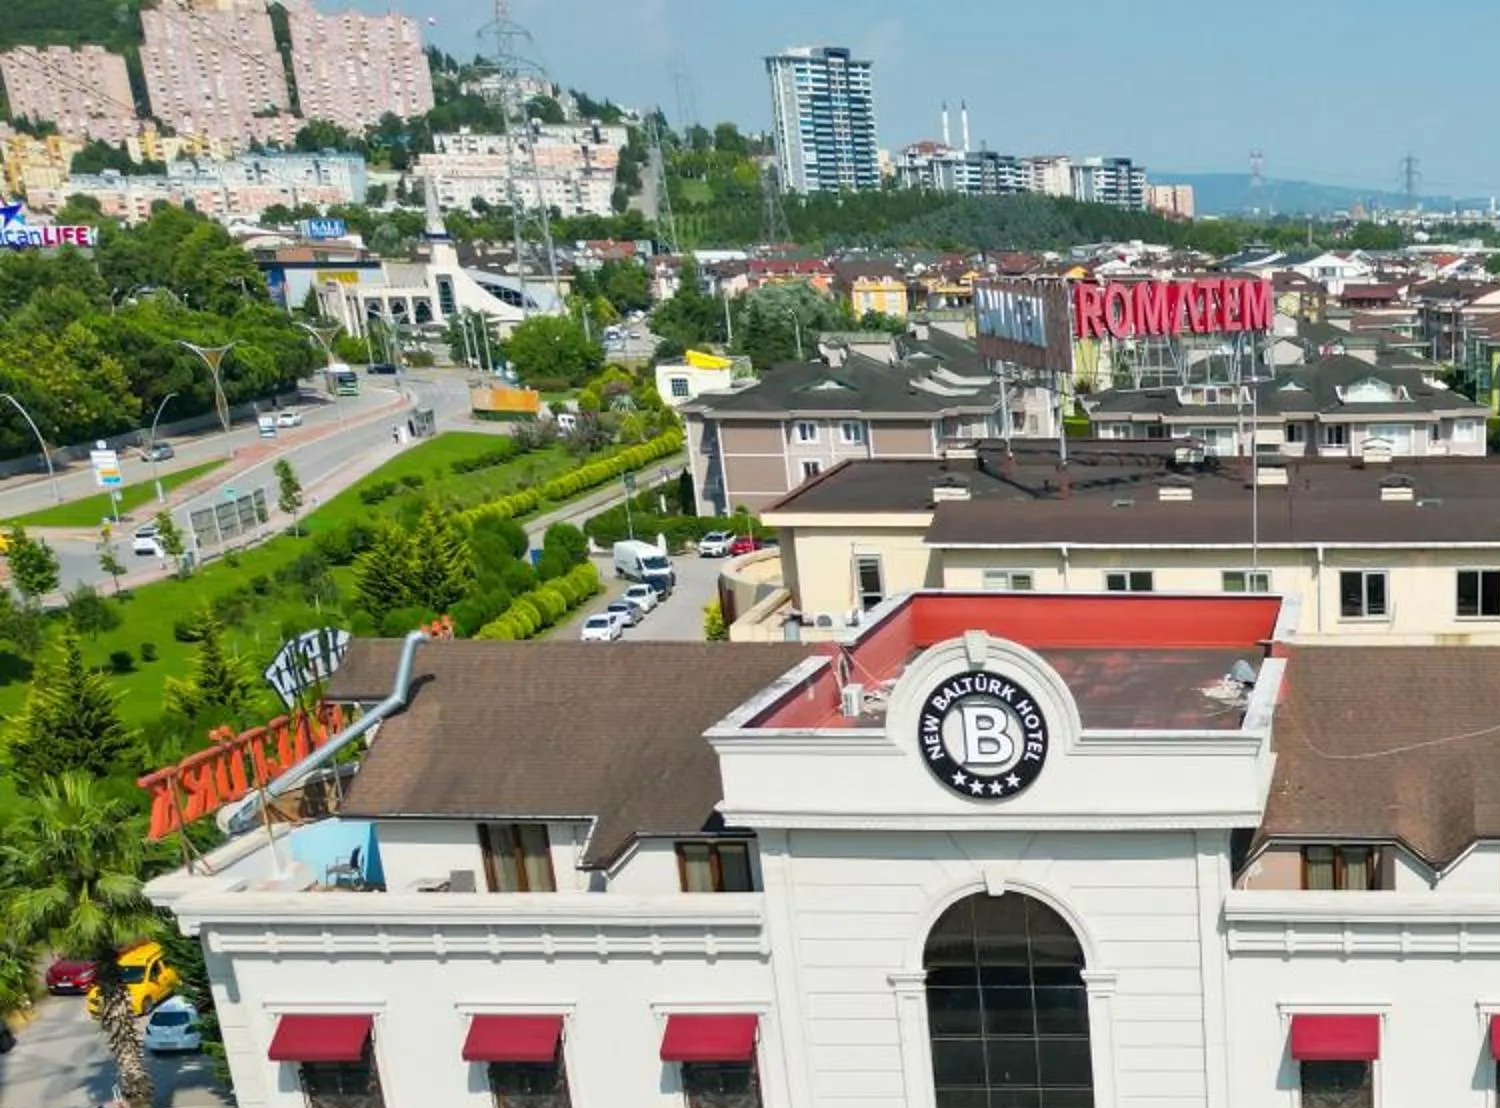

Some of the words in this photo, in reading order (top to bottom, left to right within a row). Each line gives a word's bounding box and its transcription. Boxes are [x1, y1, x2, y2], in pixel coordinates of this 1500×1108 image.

[1073, 278, 1273, 339] ROMATEM
[932, 674, 1017, 711] BALTÜRK
[924, 714, 945, 760] NEW
[962, 706, 1015, 764] B
[1016, 700, 1044, 761] HOTEL
